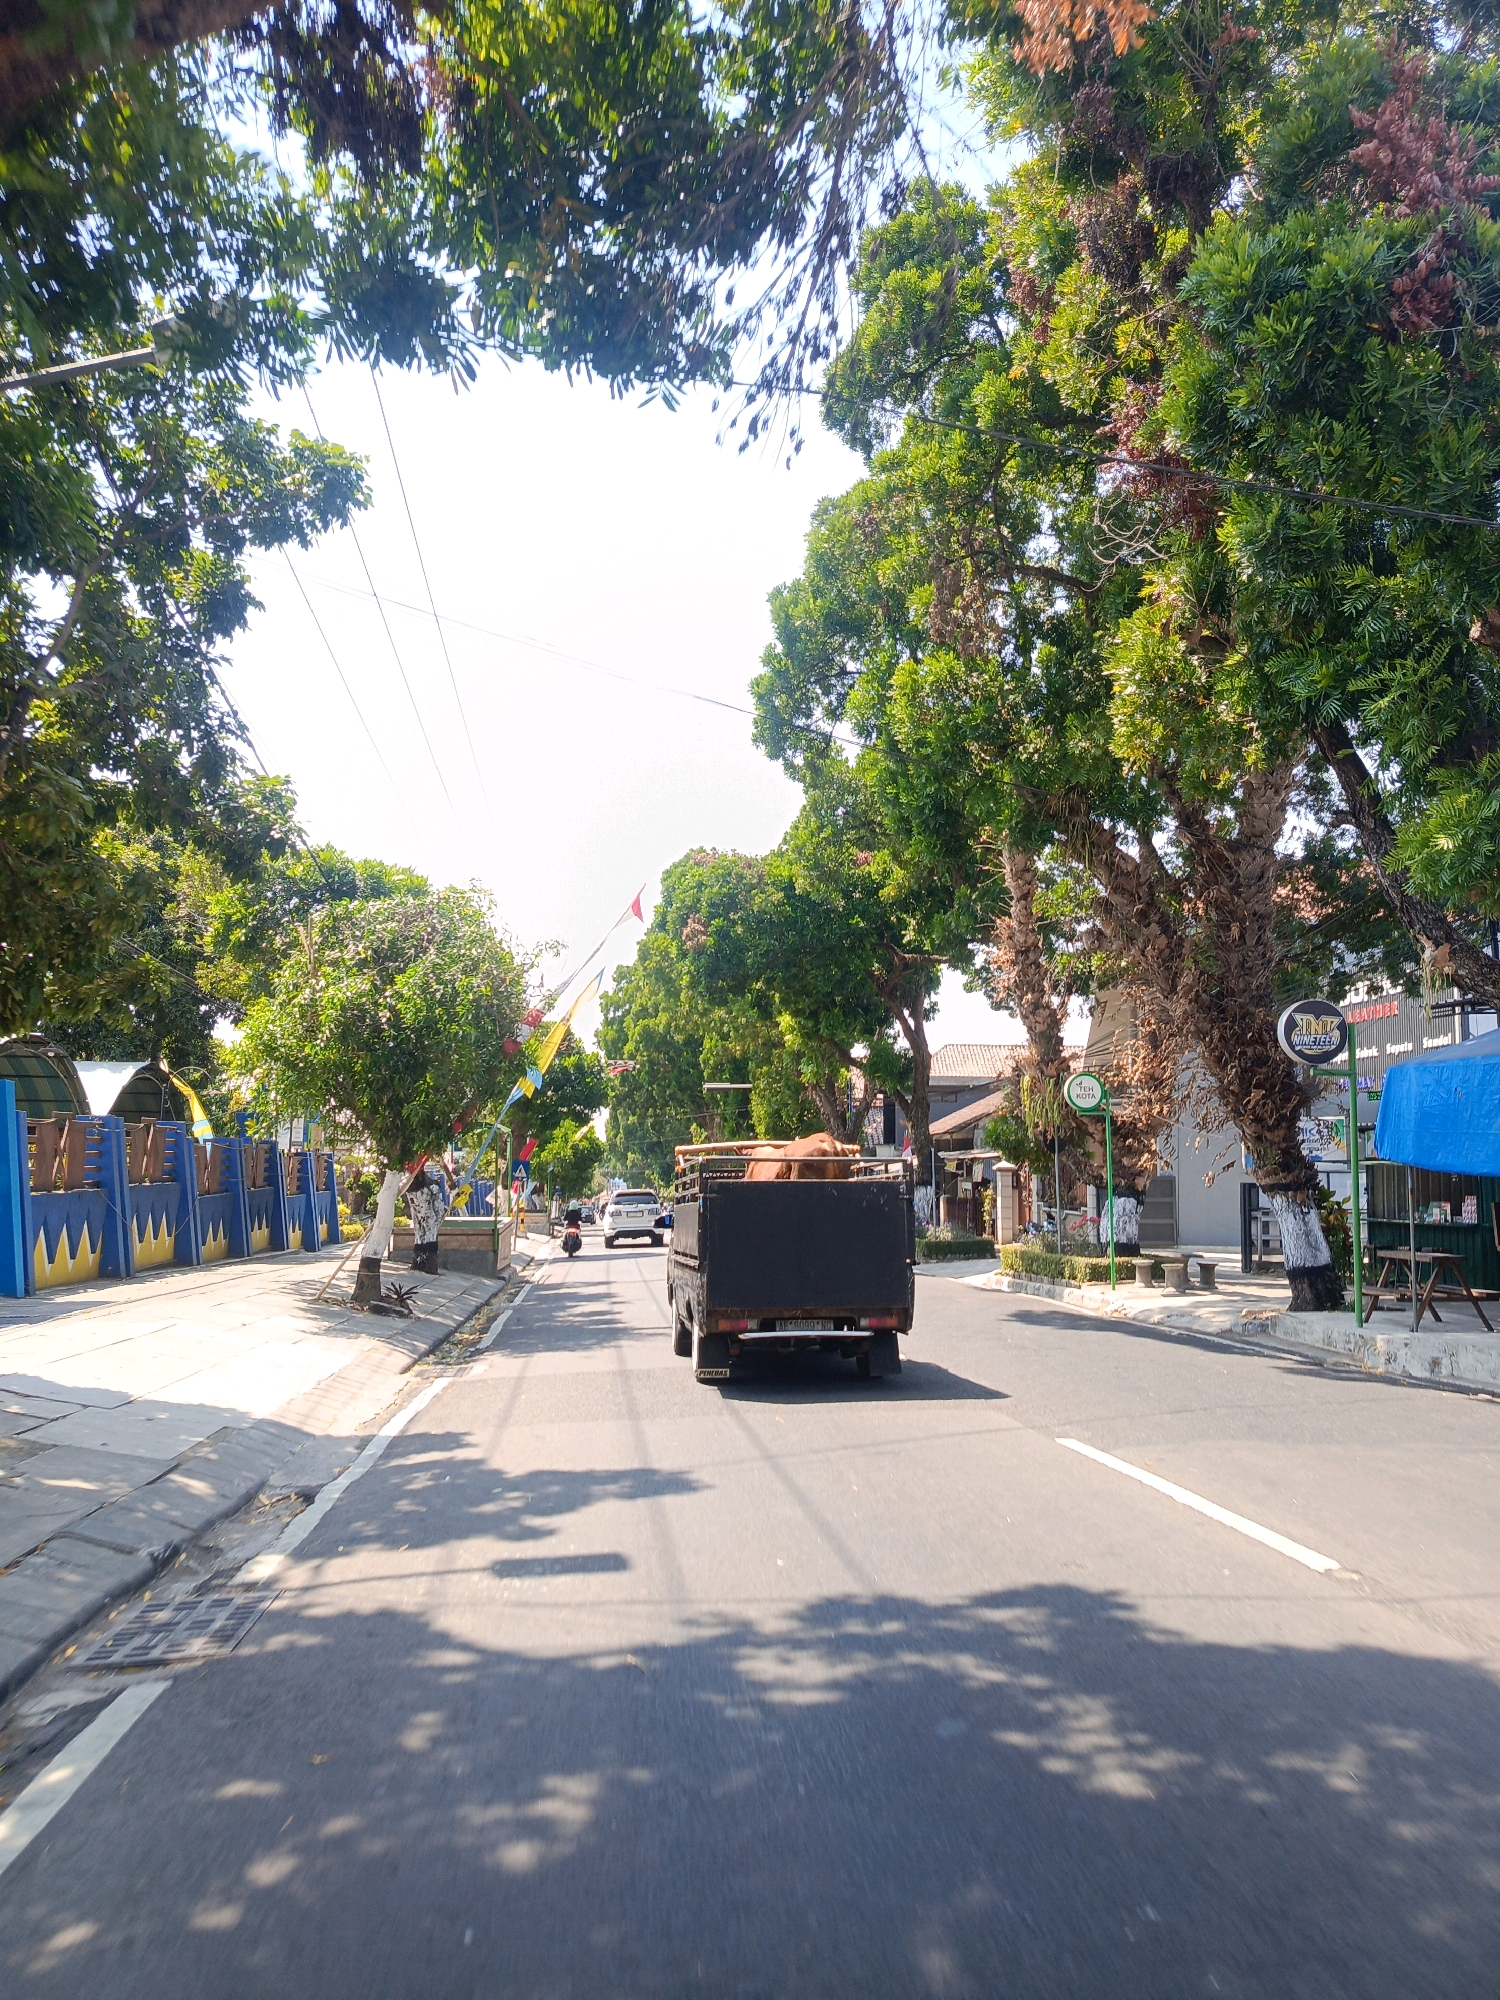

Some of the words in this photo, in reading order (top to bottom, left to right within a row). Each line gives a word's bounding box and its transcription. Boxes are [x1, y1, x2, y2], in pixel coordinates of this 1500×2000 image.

[1347, 1000, 1398, 1024] LEATHER
[1292, 1033, 1338, 1046] NINETEEN
[1423, 1032, 1452, 1049] Sandal
[1076, 1092, 1096, 1100] KOTA
